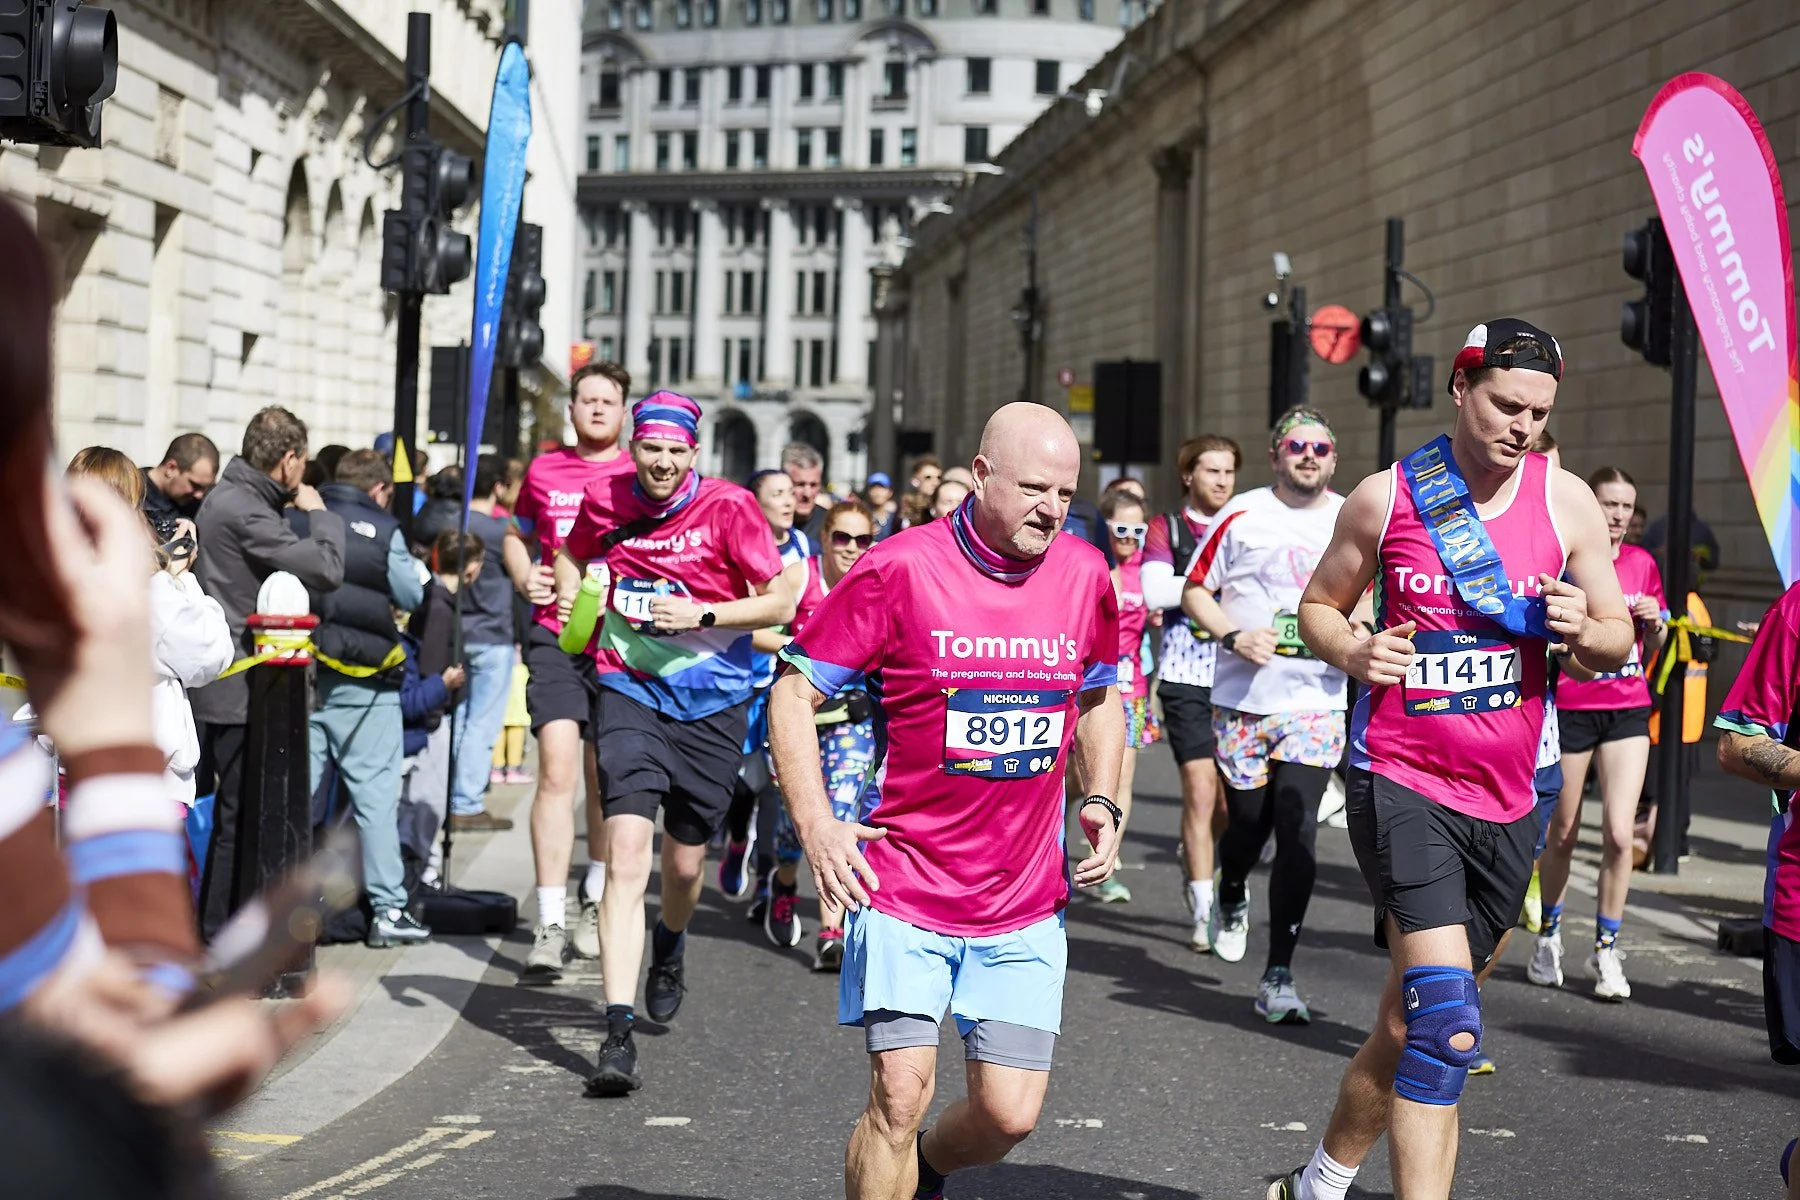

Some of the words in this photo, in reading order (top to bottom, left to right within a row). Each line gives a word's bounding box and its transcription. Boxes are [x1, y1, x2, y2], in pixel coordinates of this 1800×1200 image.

[547, 489, 585, 507] Tom
[1464, 573, 1506, 615] BO
[622, 595, 653, 614] 11
[930, 630, 1077, 667] Tommy's
[1452, 635, 1477, 644] TOM
[931, 668, 948, 678] The
[951, 668, 1002, 680] pregnancy
[1005, 669, 1024, 679] and
[1027, 670, 1051, 681] baby
[1415, 652, 1516, 684] 11417
[983, 694, 1040, 704] NICHOLAS
[965, 716, 1050, 745] 8912
